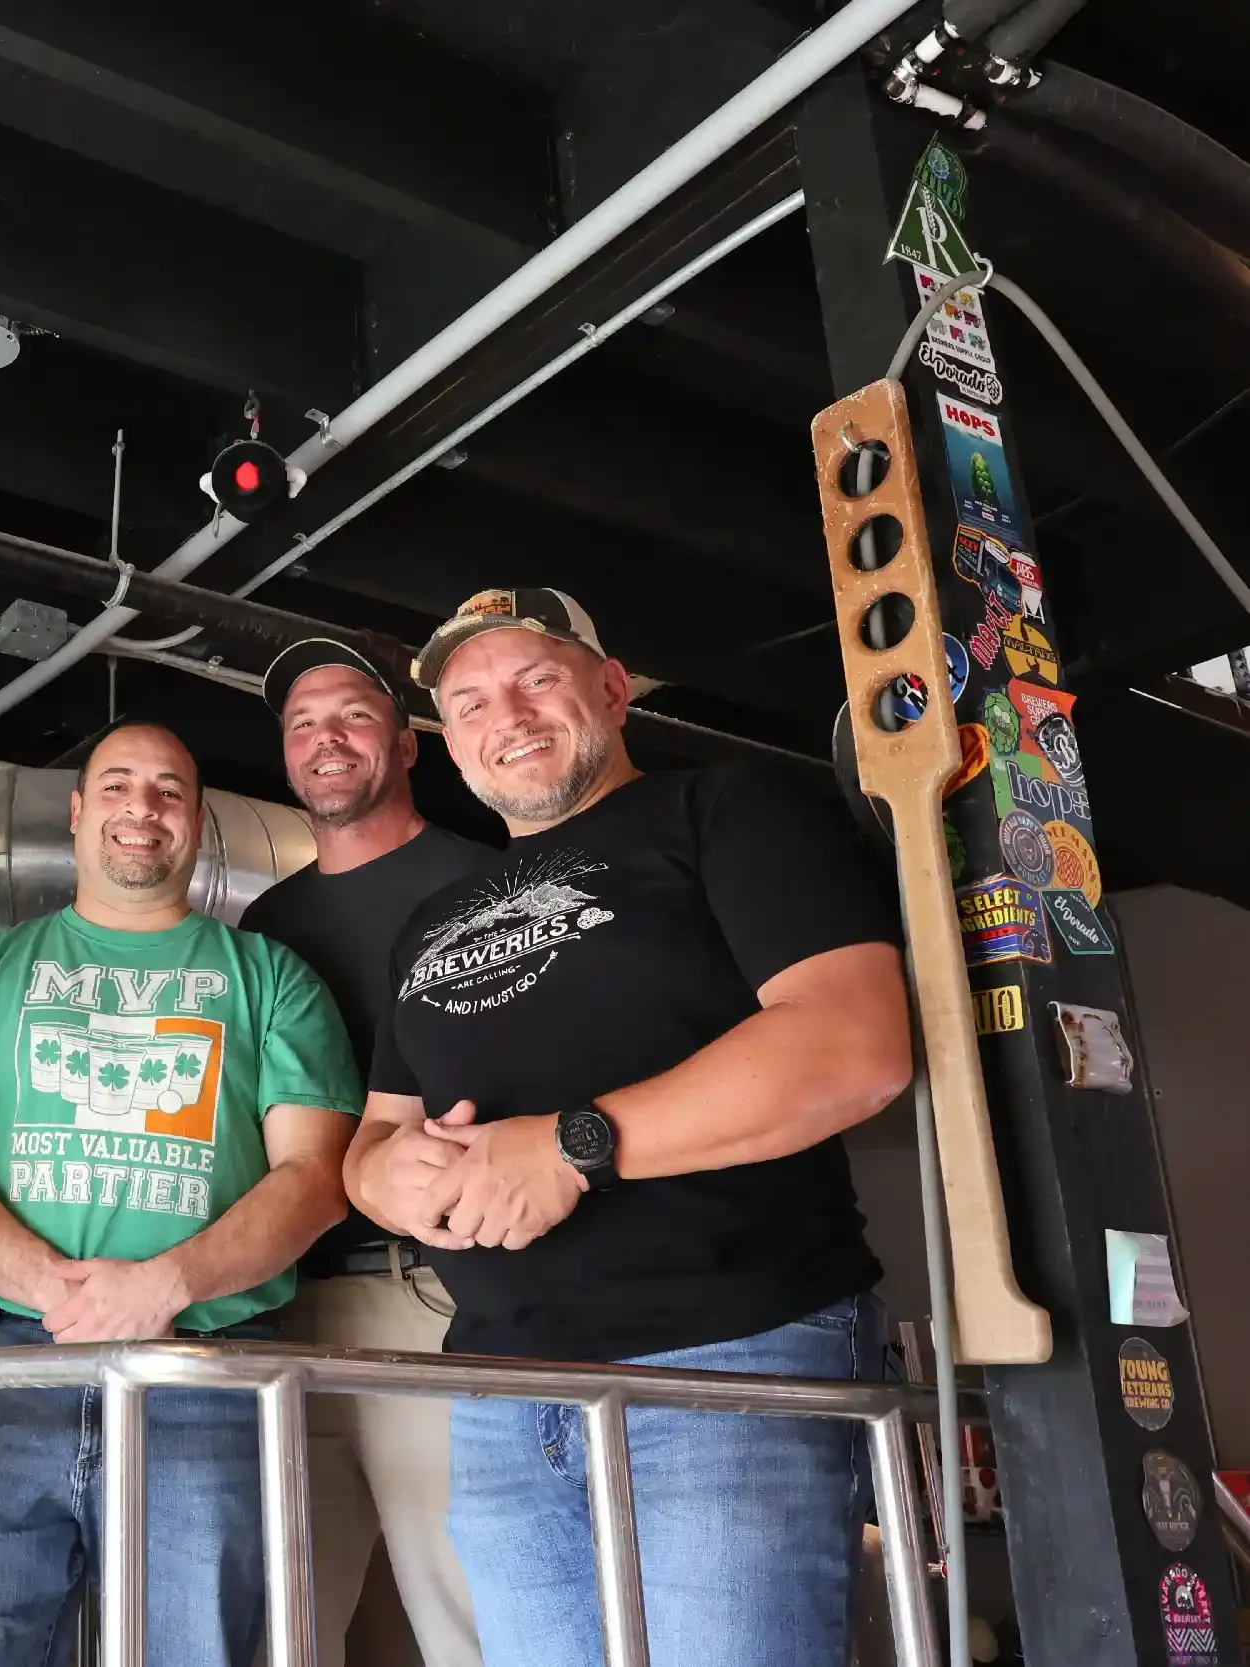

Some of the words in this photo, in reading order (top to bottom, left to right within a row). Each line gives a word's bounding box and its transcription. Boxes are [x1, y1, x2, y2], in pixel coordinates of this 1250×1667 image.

[900, 243, 922, 261] 1847
[921, 344, 935, 364] El
[935, 357, 986, 392] Dorado
[945, 404, 996, 437] HOPS
[1016, 561, 1034, 580] ABS
[1021, 693, 1058, 713] BREWERS
[960, 888, 1021, 914] SELECT
[960, 906, 1037, 933] GREDIENTS
[1054, 895, 1068, 912] El
[1062, 907, 1100, 944] Dorado
[410, 914, 569, 989] BREWERIES
[483, 929, 498, 939] THE
[24, 959, 229, 1015] MVP
[444, 999, 472, 1016] AND
[472, 1000, 479, 1014] I
[480, 987, 515, 1012] MUST
[515, 972, 538, 993] GO
[456, 979, 474, 991] ARE
[476, 965, 516, 985] CALLING
[972, 990, 1016, 1031] TIO
[11, 1131, 72, 1157] MOST
[80, 1133, 215, 1174] VALUABLE
[9, 1160, 210, 1220] PARTIER
